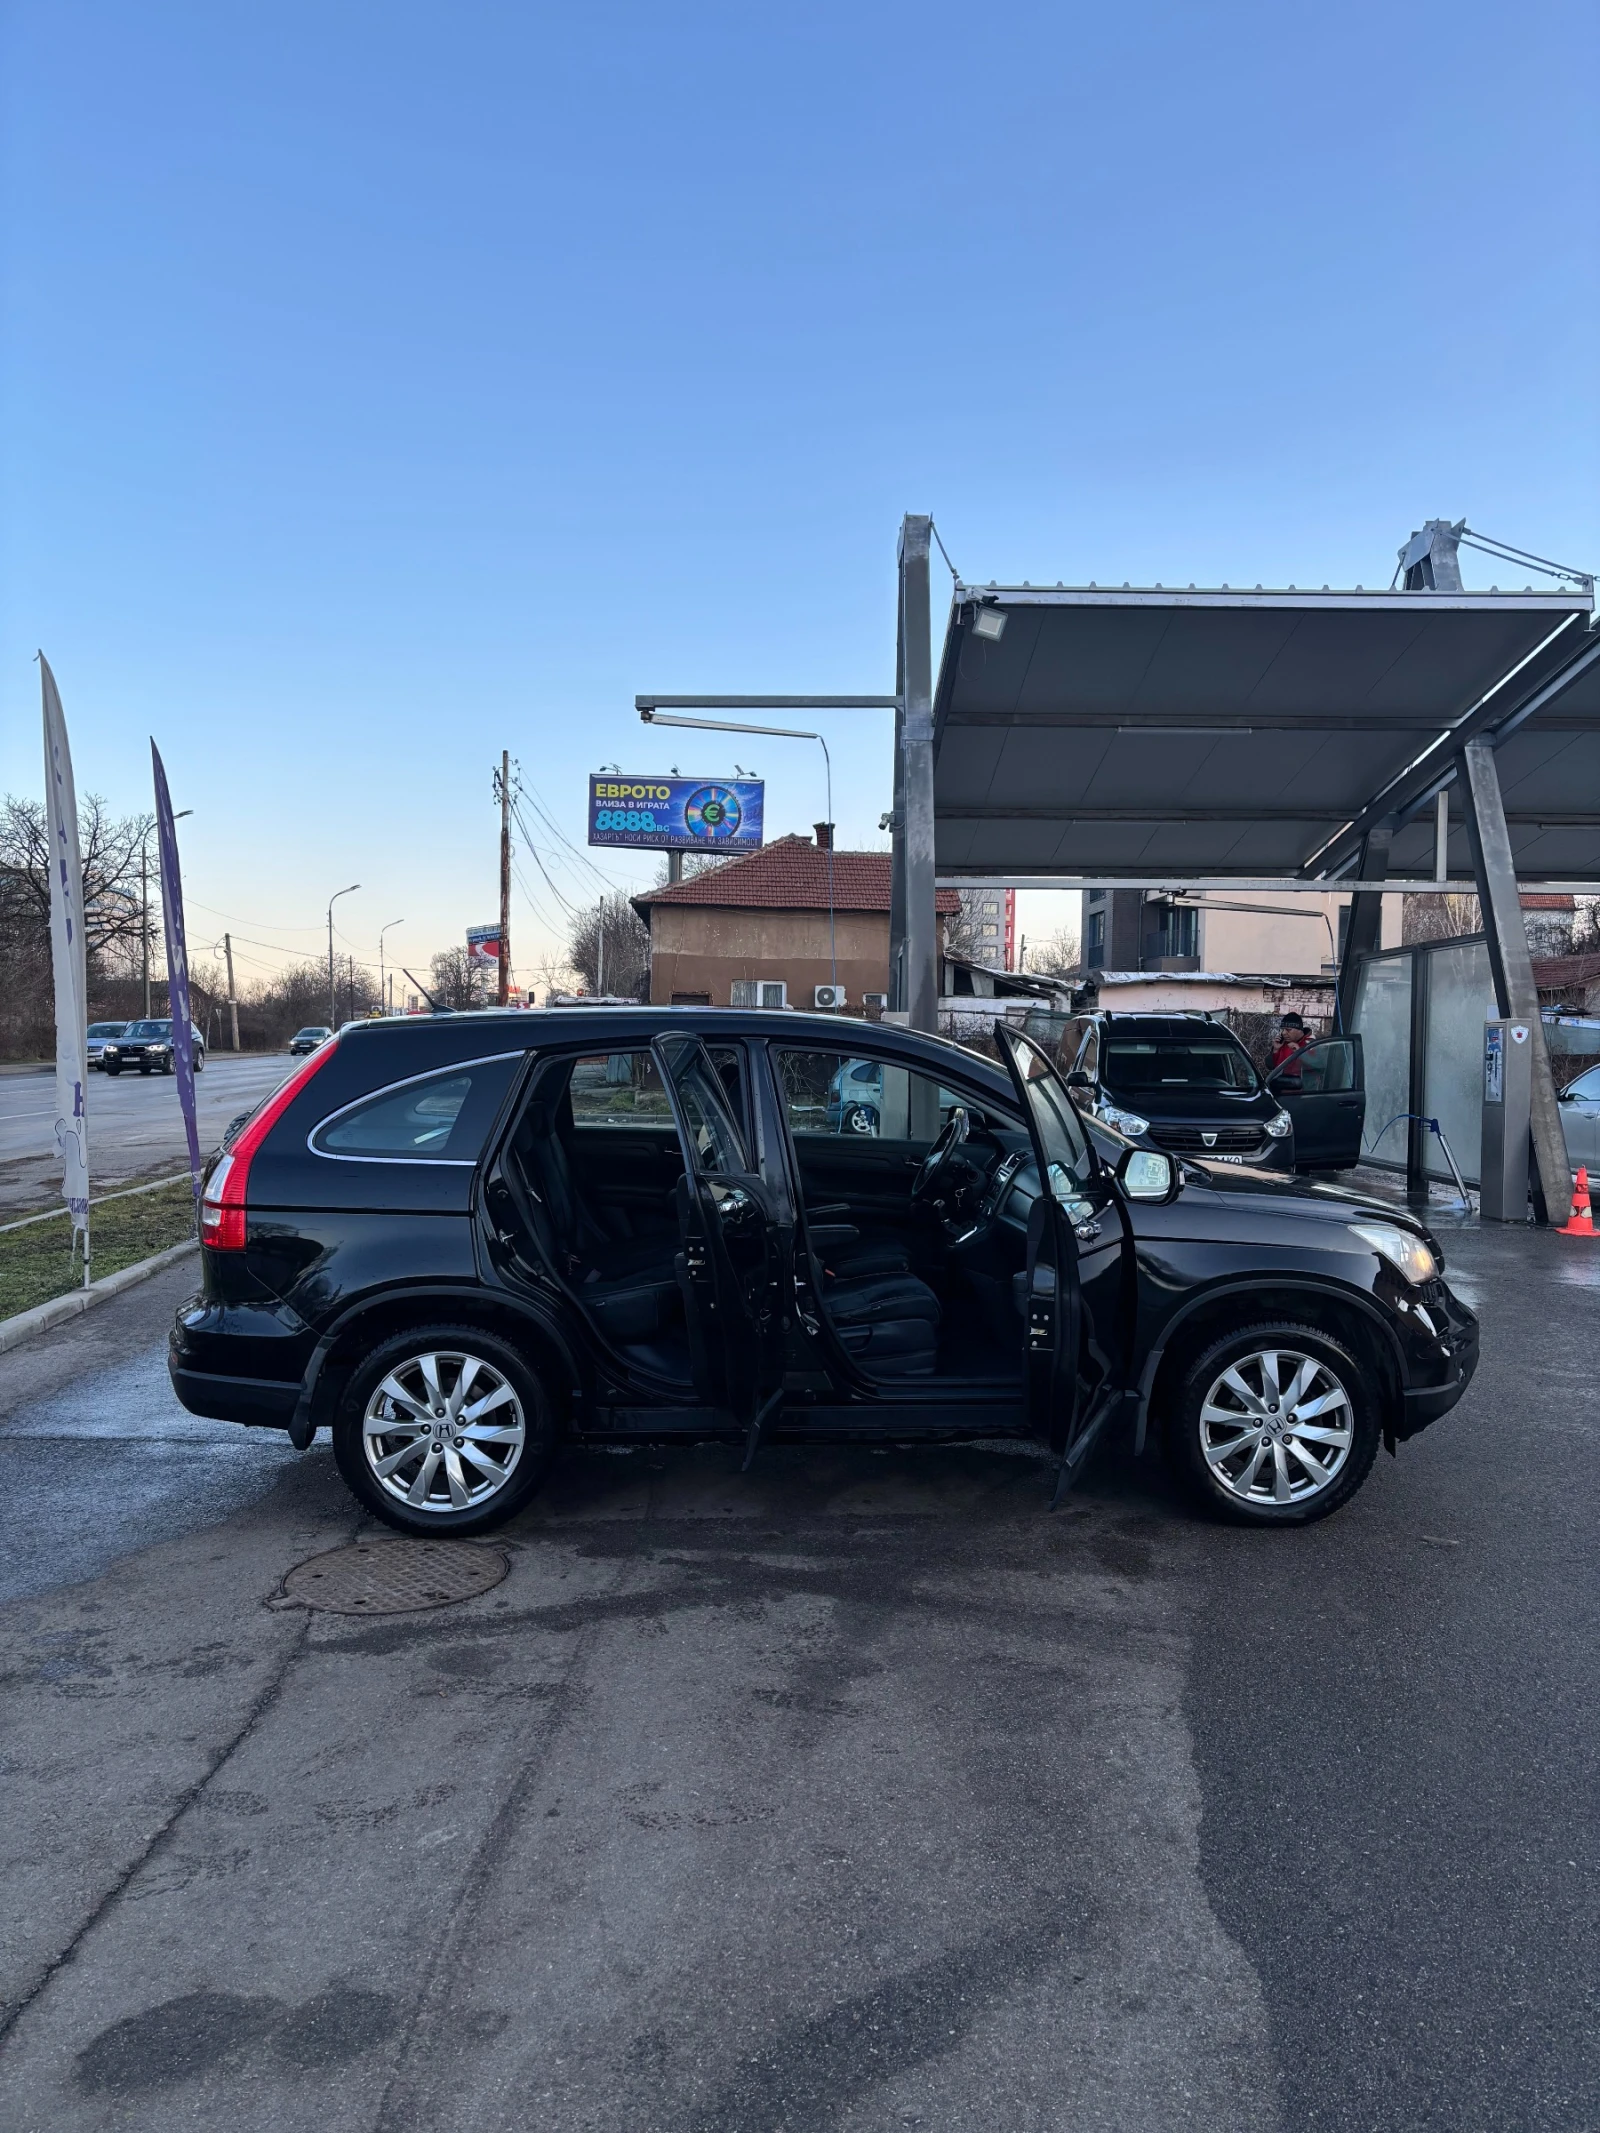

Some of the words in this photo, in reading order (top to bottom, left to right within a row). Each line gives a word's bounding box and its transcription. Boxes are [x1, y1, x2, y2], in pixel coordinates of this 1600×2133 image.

[596, 784, 671, 800] ЕВРОТО
[596, 800, 626, 808] ВЛИЗА
[636, 801, 670, 809] ИГРАТА
[625, 833, 641, 842] НОСИ
[643, 834, 659, 843] РИСК
[661, 835, 669, 843] ОТ
[670, 835, 706, 845] РАЗВИВАНЕ
[708, 837, 716, 845] НА
[717, 837, 758, 846] ЗАВИСИМОСТ
